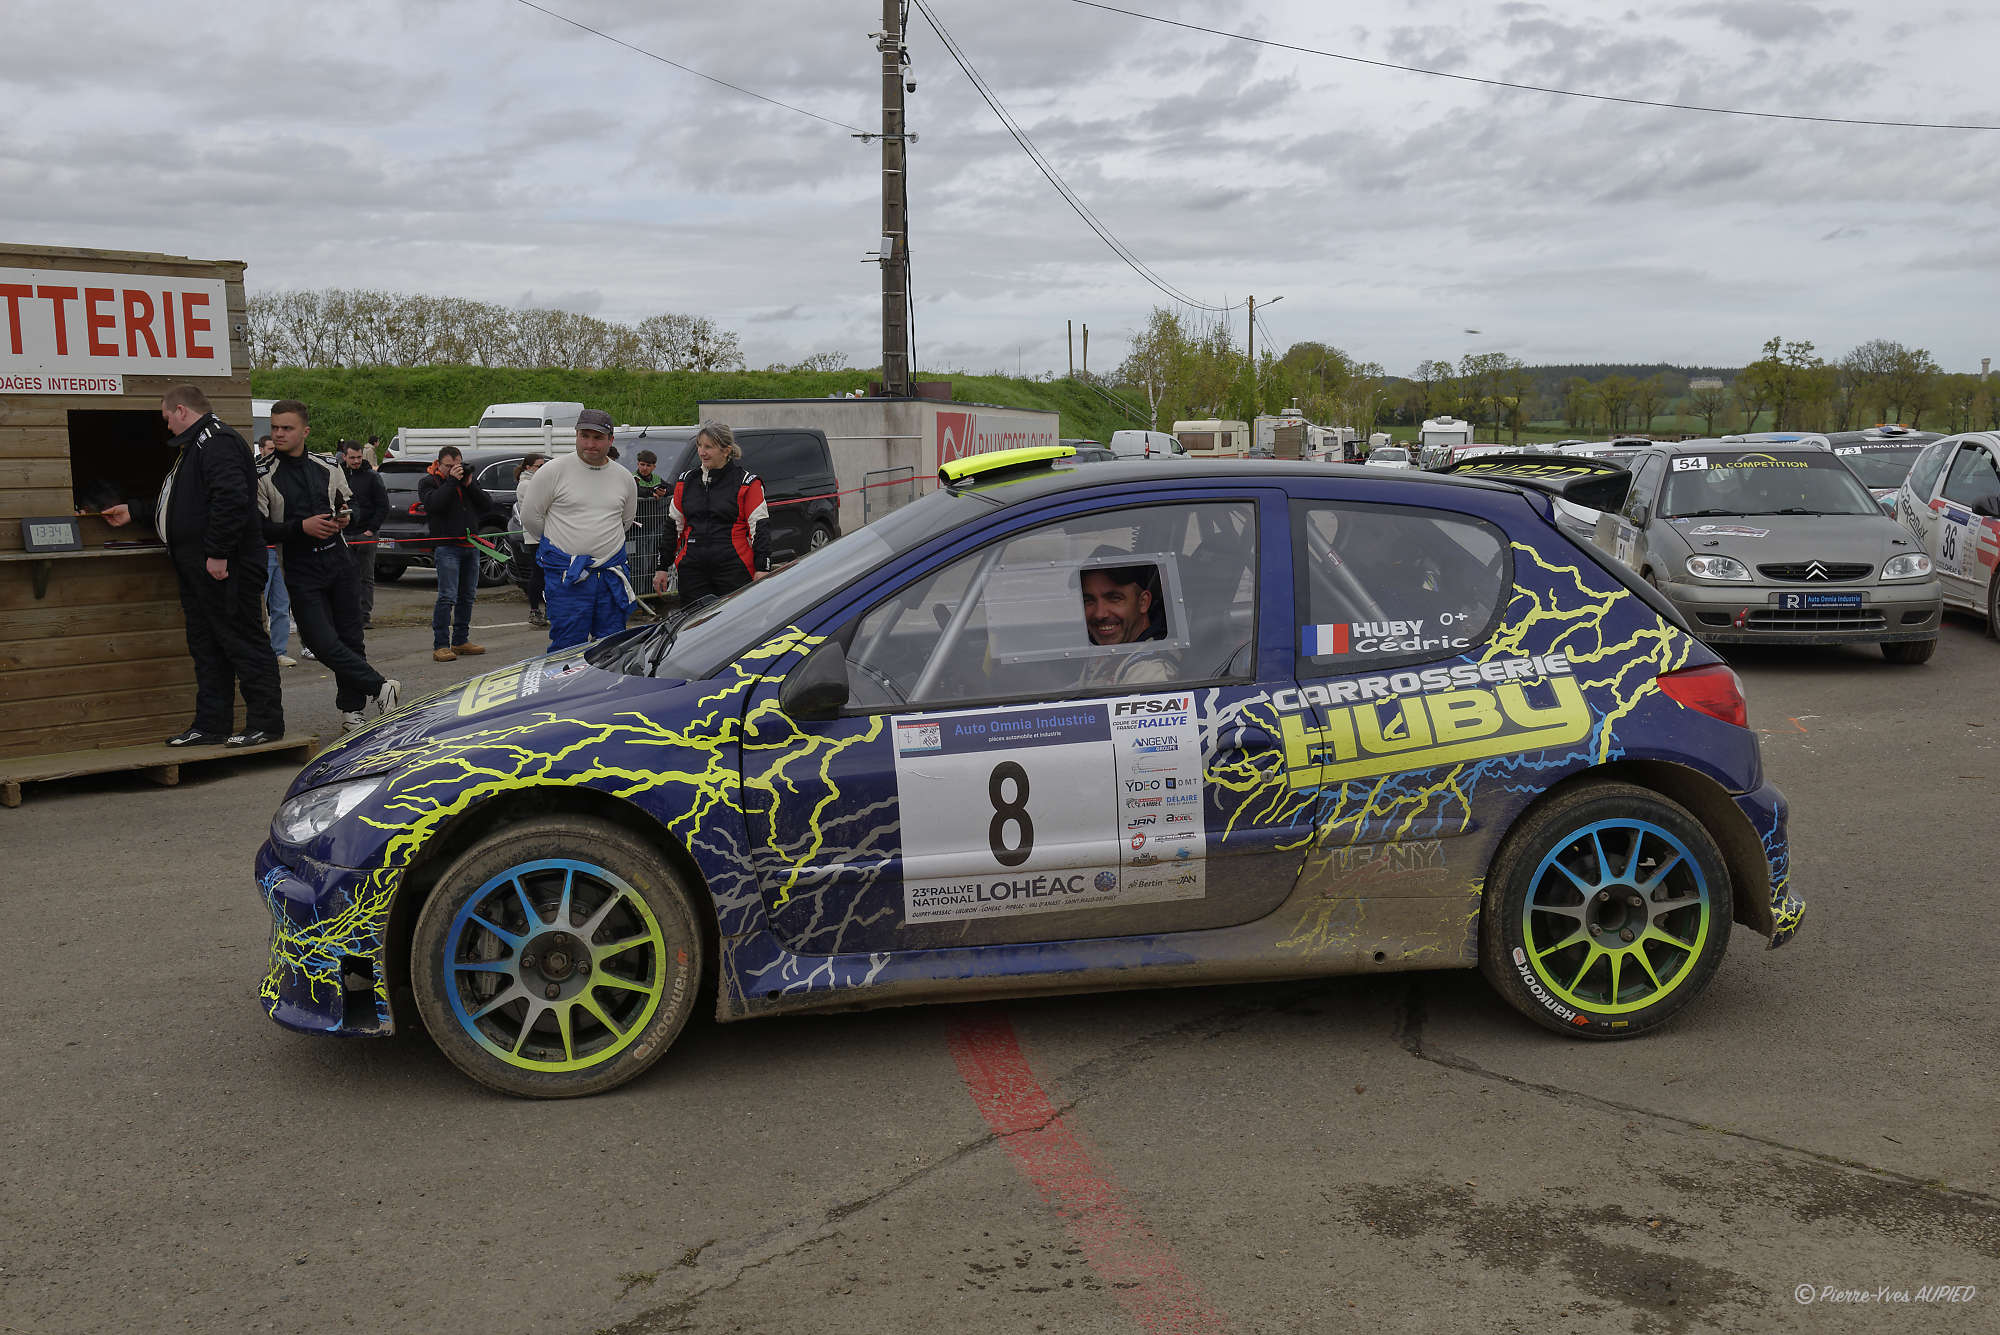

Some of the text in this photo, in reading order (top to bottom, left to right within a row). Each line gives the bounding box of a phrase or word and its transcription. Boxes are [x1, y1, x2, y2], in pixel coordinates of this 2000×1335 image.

[48, 378, 117, 391] INTERDITS
[1679, 458, 1701, 470] 54
[1726, 460, 1809, 469] COMPETITION
[1942, 523, 1958, 561] 36
[1352, 619, 1424, 638] HUBY
[1355, 635, 1471, 653] Cédric
[1272, 653, 1572, 711] CARROSSERIE
[1114, 698, 1182, 716] FFSA
[954, 712, 1096, 737] Auto Omnia Industrie
[1138, 716, 1188, 729] RALLYE
[1132, 735, 1178, 748] ANGEVIN
[1279, 675, 1594, 790] HUBY
[1166, 794, 1198, 803] DELAIRE
[988, 760, 1035, 867] 8
[929, 884, 974, 896] RALLYE
[976, 875, 1085, 902] LOHÉAC
[913, 894, 975, 908] NATIONAL
